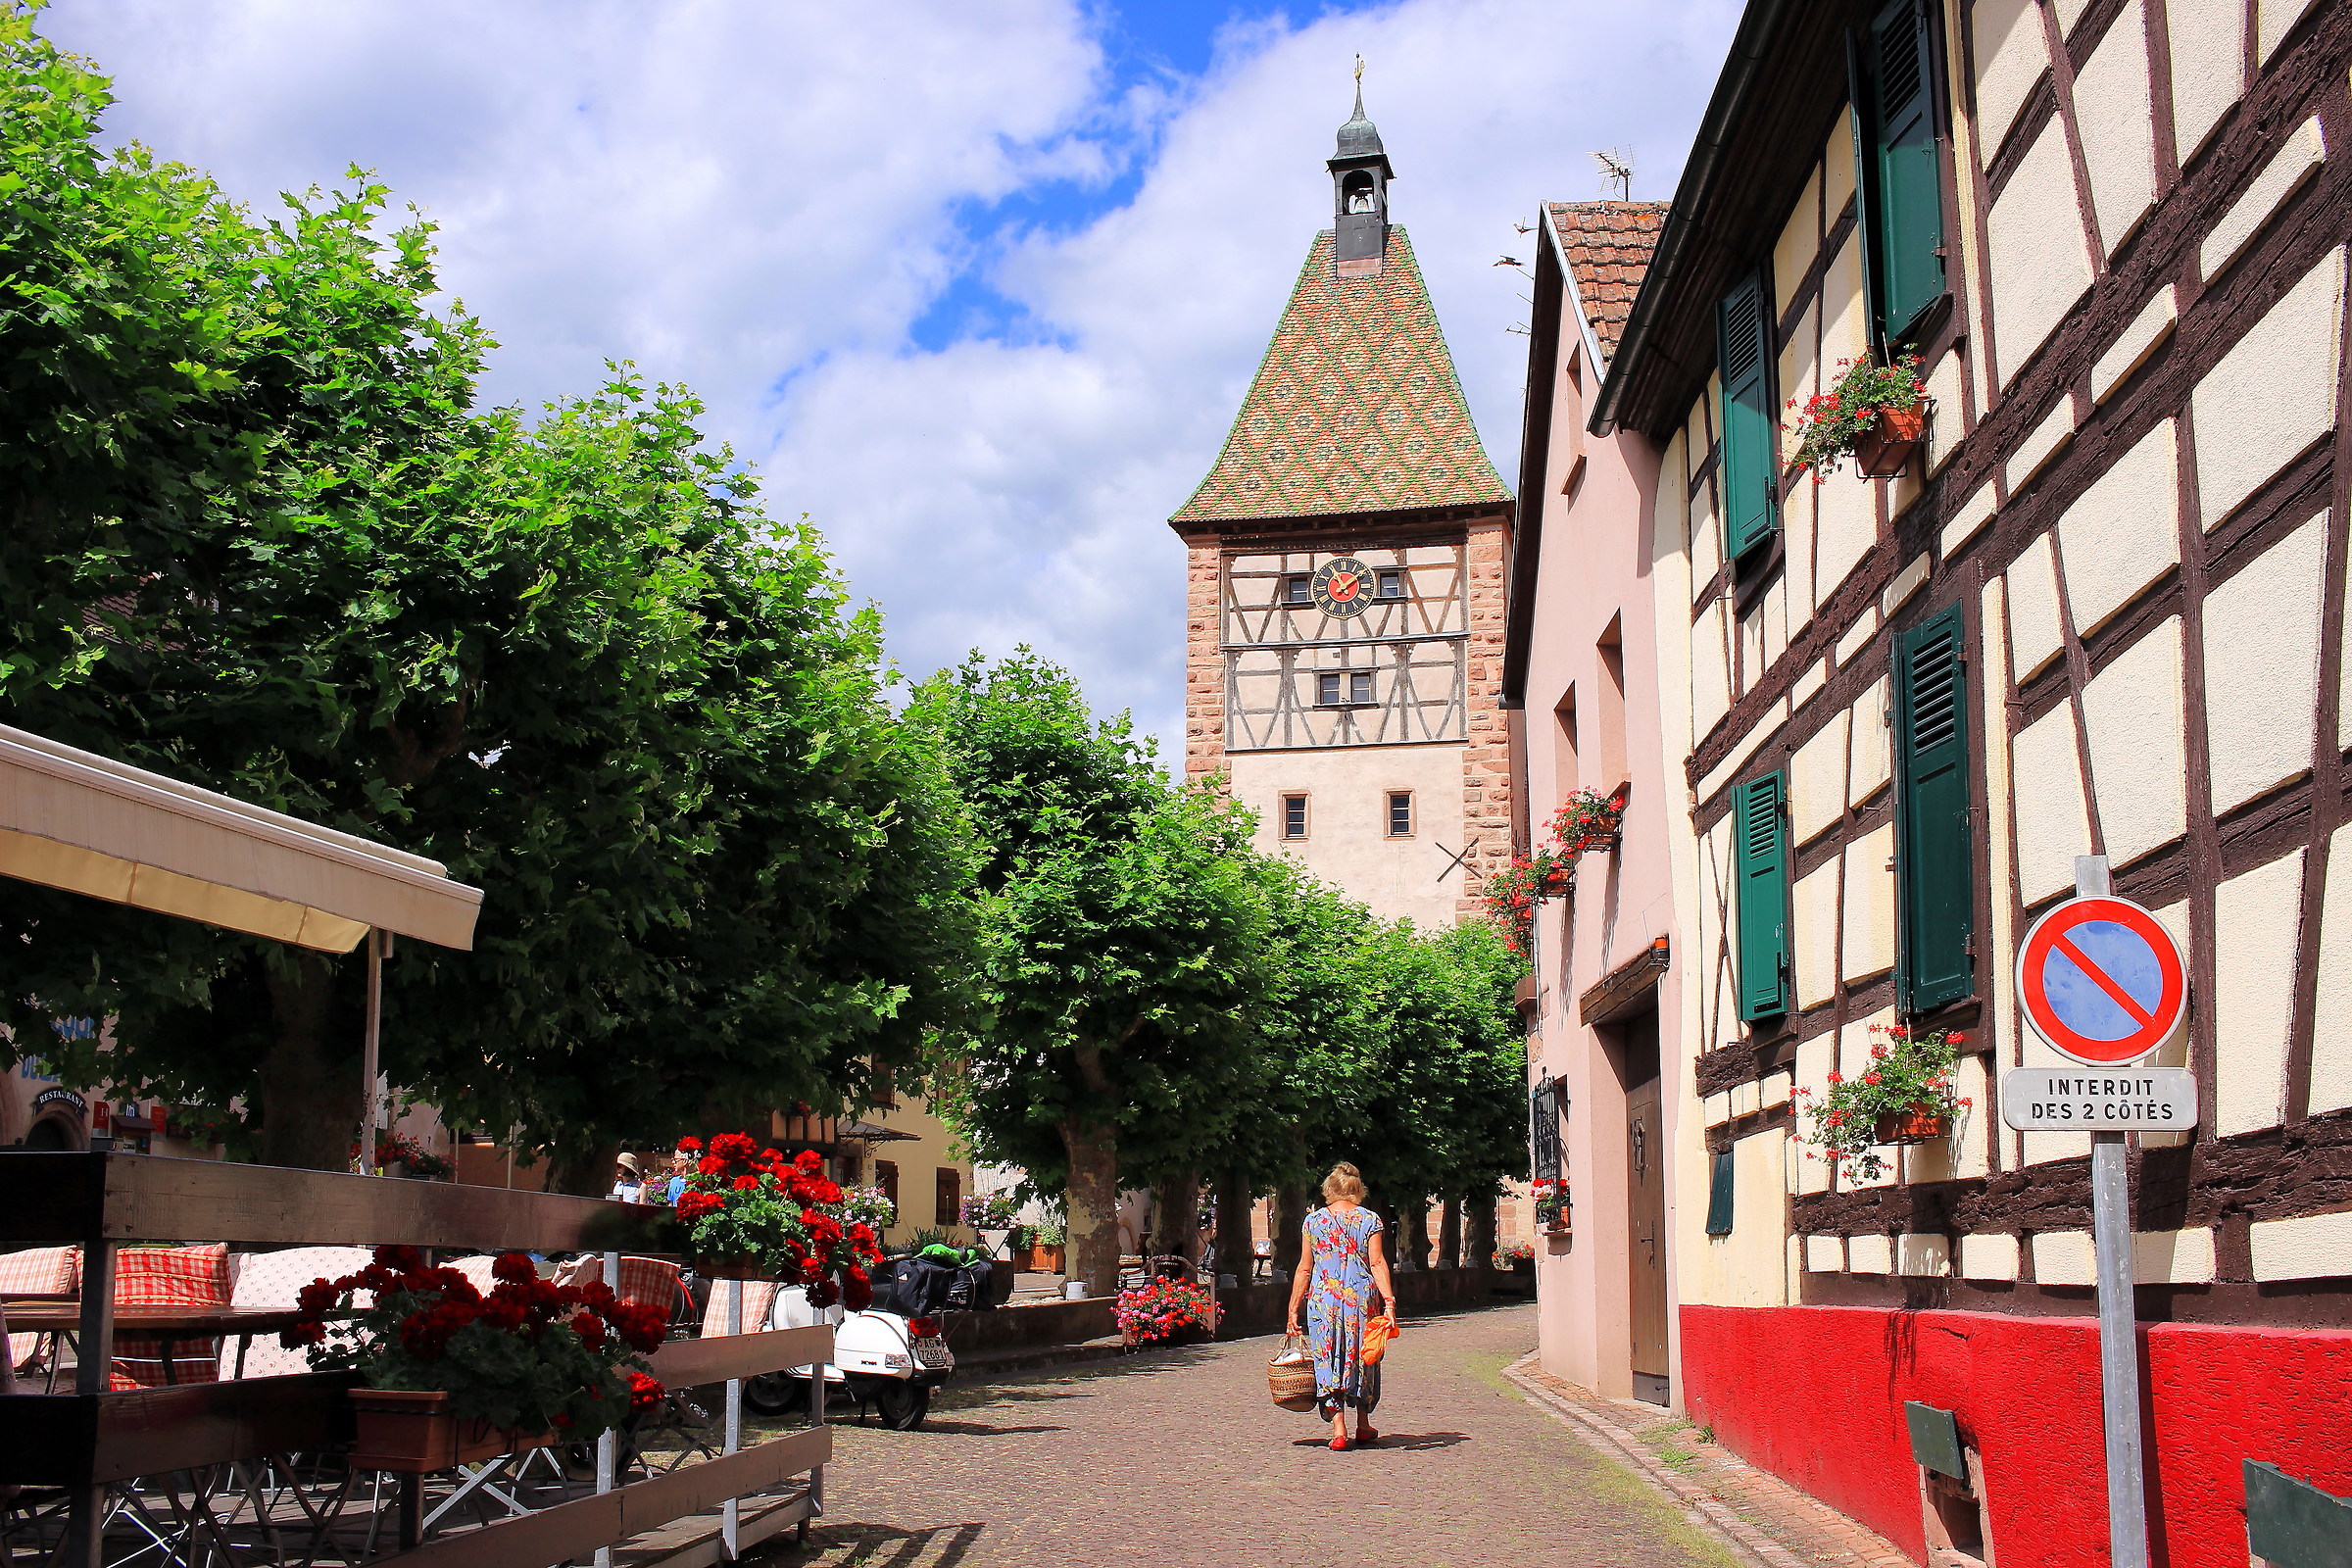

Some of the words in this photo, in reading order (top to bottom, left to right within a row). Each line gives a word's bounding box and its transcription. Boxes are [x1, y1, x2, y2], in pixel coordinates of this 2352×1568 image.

[2048, 1079, 2154, 1096] INTERDIT
[38, 1090, 84, 1108] RESTAURANT
[2032, 1103, 2073, 1119] DES
[2082, 1103, 2096, 1119] 2
[2104, 1099, 2174, 1119] CÔTÉS
[924, 1339, 935, 1348] AG
[919, 1349, 945, 1360] 72681
